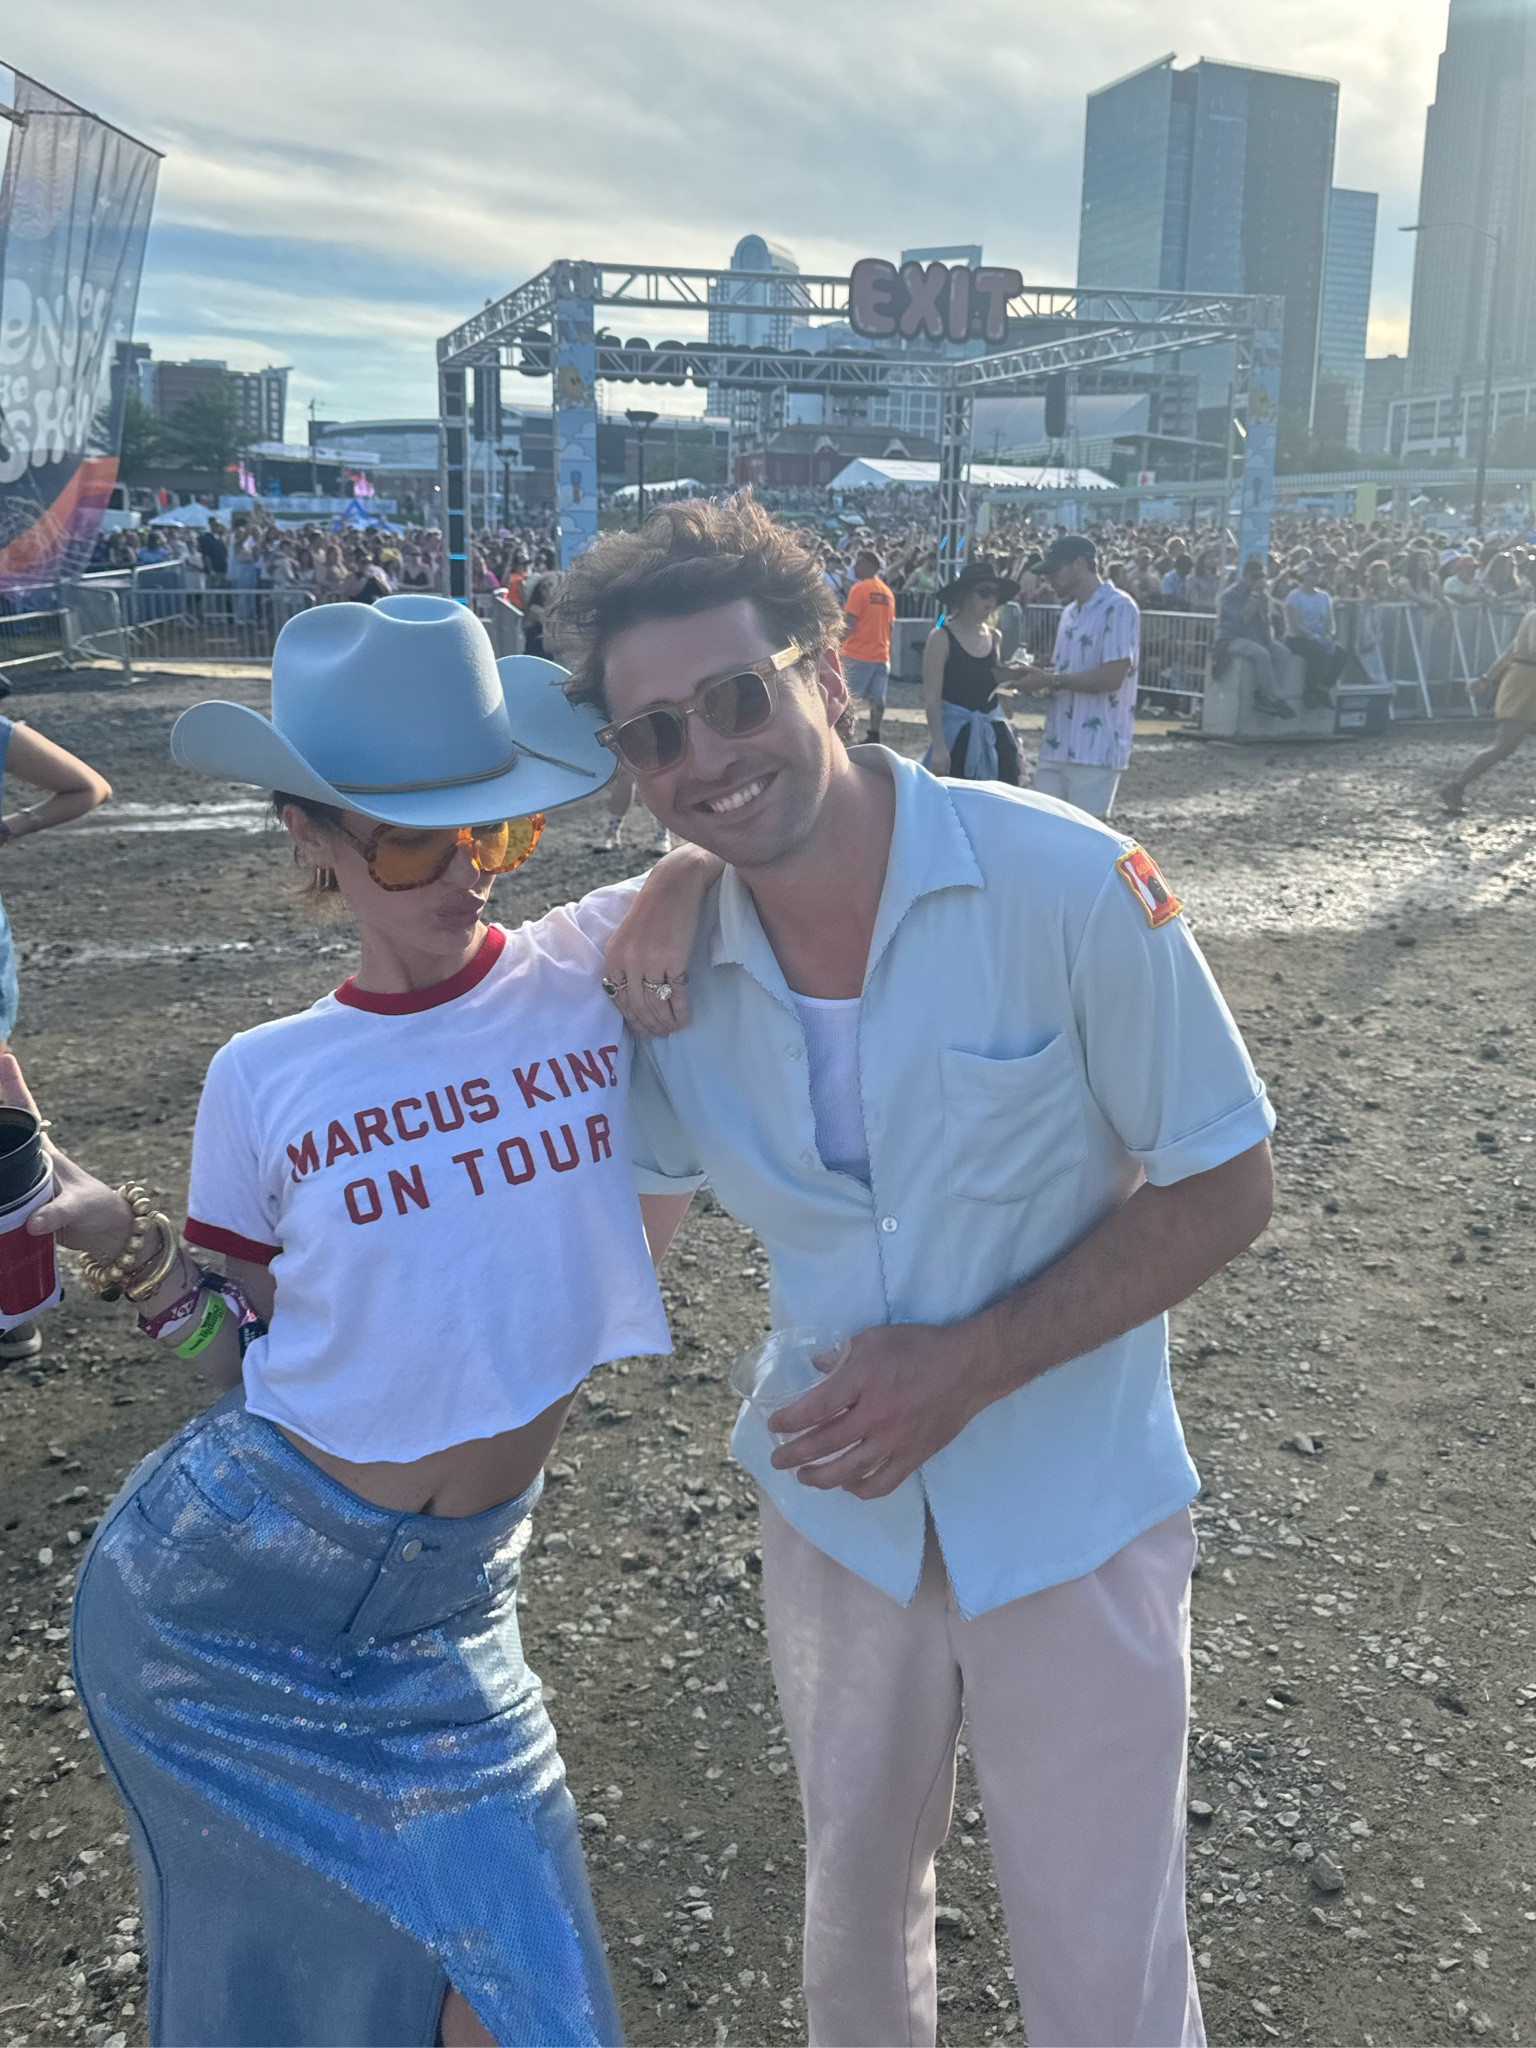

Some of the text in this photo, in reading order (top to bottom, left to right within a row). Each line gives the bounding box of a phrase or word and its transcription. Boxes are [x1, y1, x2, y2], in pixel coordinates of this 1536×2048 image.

[850, 258, 1023, 343] EXIT
[286, 1077, 499, 1183] MARCUS
[343, 1113, 612, 1225] ON TOUR
